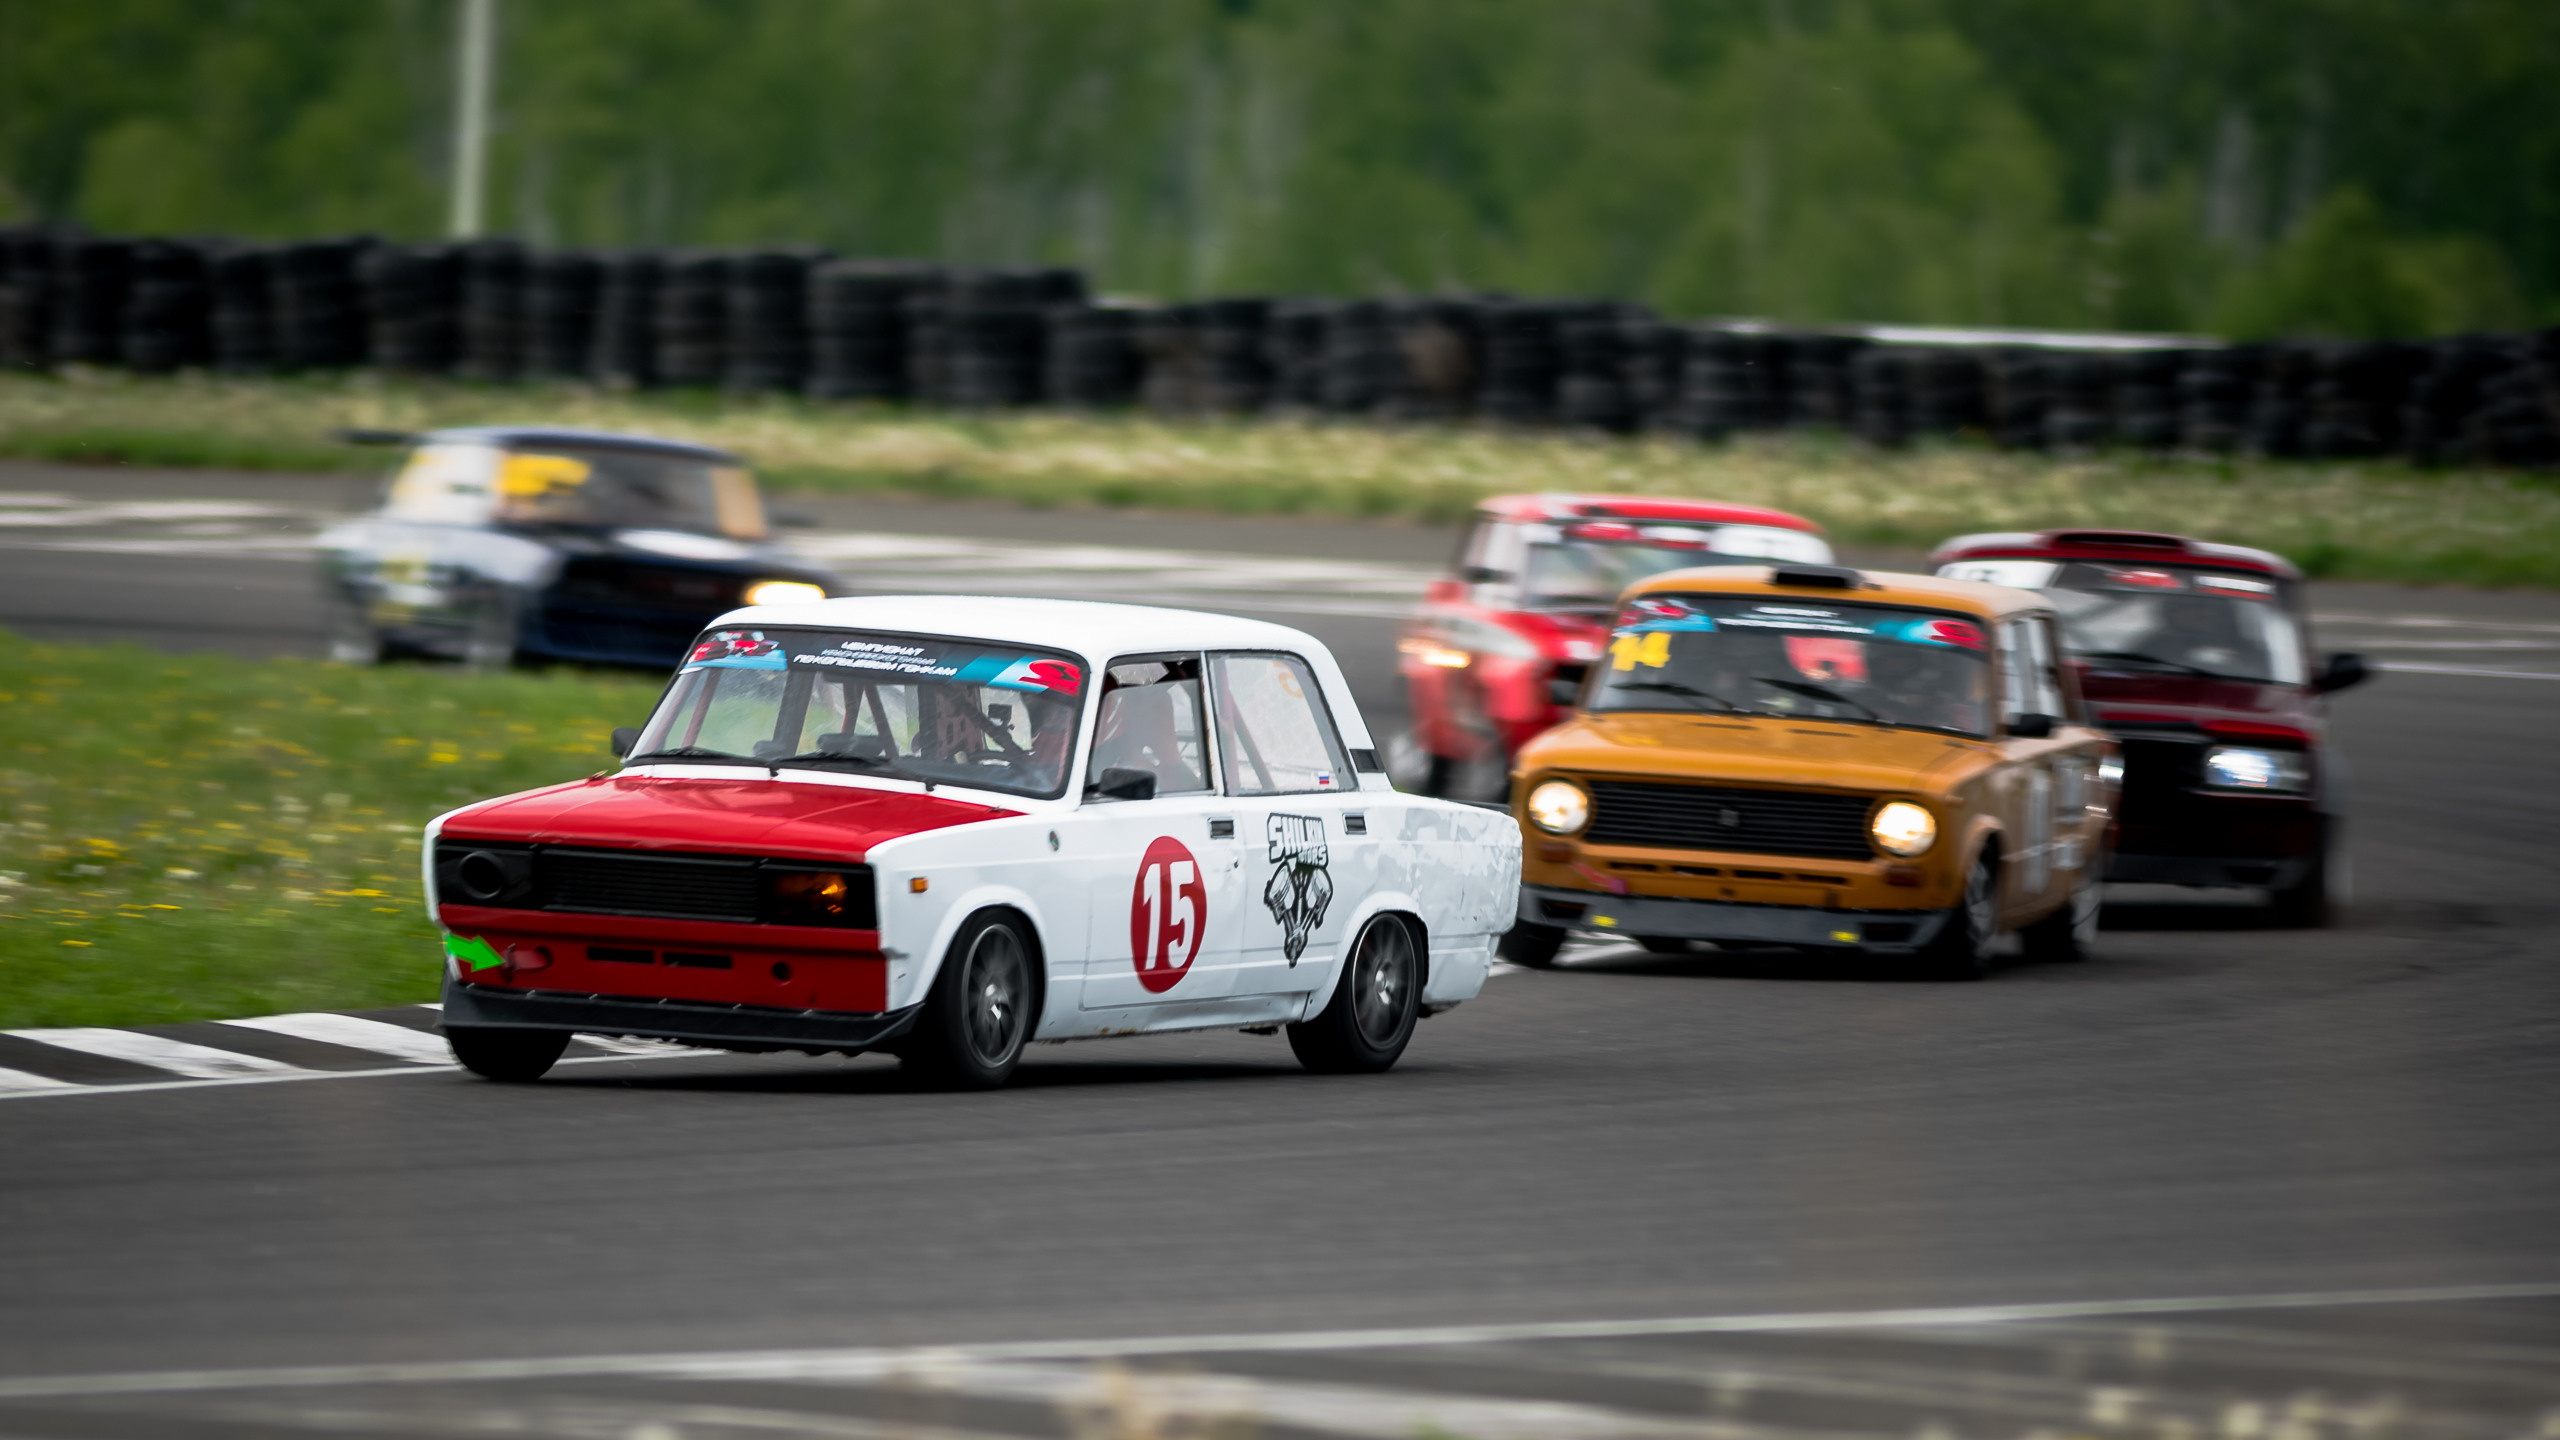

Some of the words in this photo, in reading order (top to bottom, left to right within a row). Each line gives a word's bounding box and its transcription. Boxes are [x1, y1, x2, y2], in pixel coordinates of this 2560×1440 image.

[841, 641, 925, 656] ЧЕМПИОНАТ
[1608, 632, 1671, 671] 14
[897, 663, 958, 677] ГОНКАМ
[1143, 861, 1194, 970] 15
